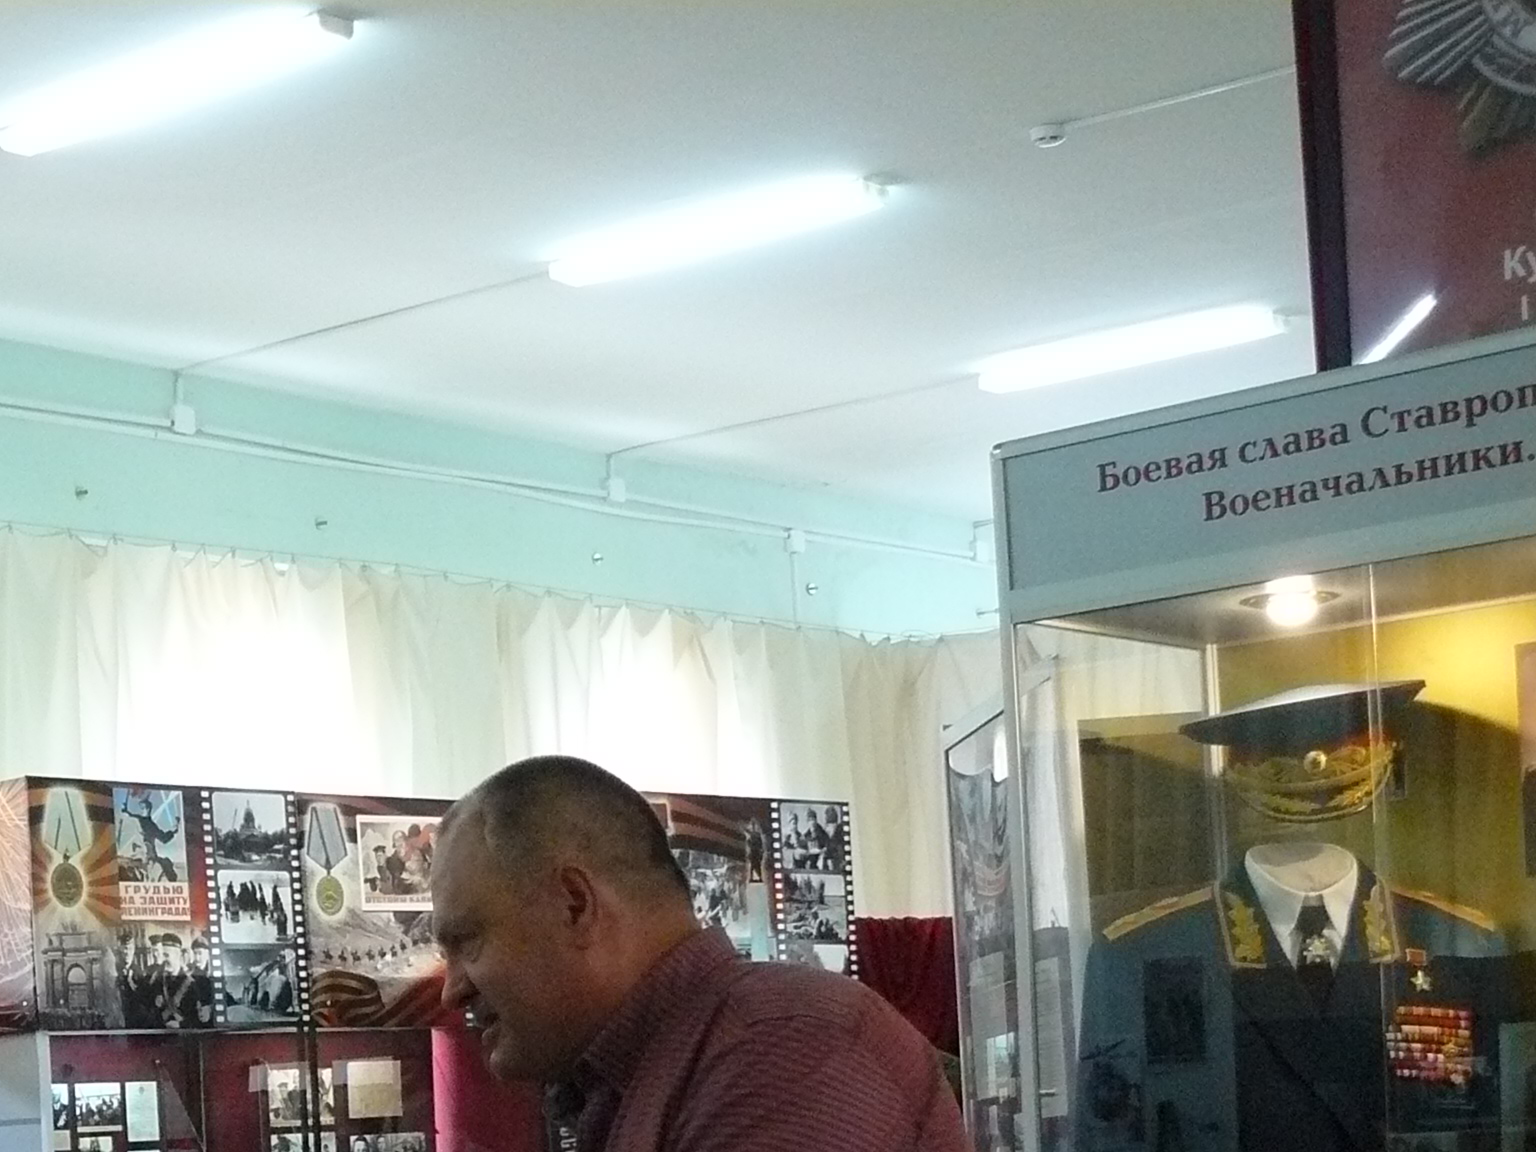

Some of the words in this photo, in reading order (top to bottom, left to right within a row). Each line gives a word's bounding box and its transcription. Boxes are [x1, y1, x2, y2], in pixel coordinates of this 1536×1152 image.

[1096, 446, 1228, 493] Боевая
[1238, 422, 1350, 464] слава
[1360, 384, 1536, 439] Ставроп
[1201, 440, 1536, 522] Военачальники.
[124, 885, 183, 894] ГРУДЬЮ
[139, 896, 188, 905] ЗАЩИТУ
